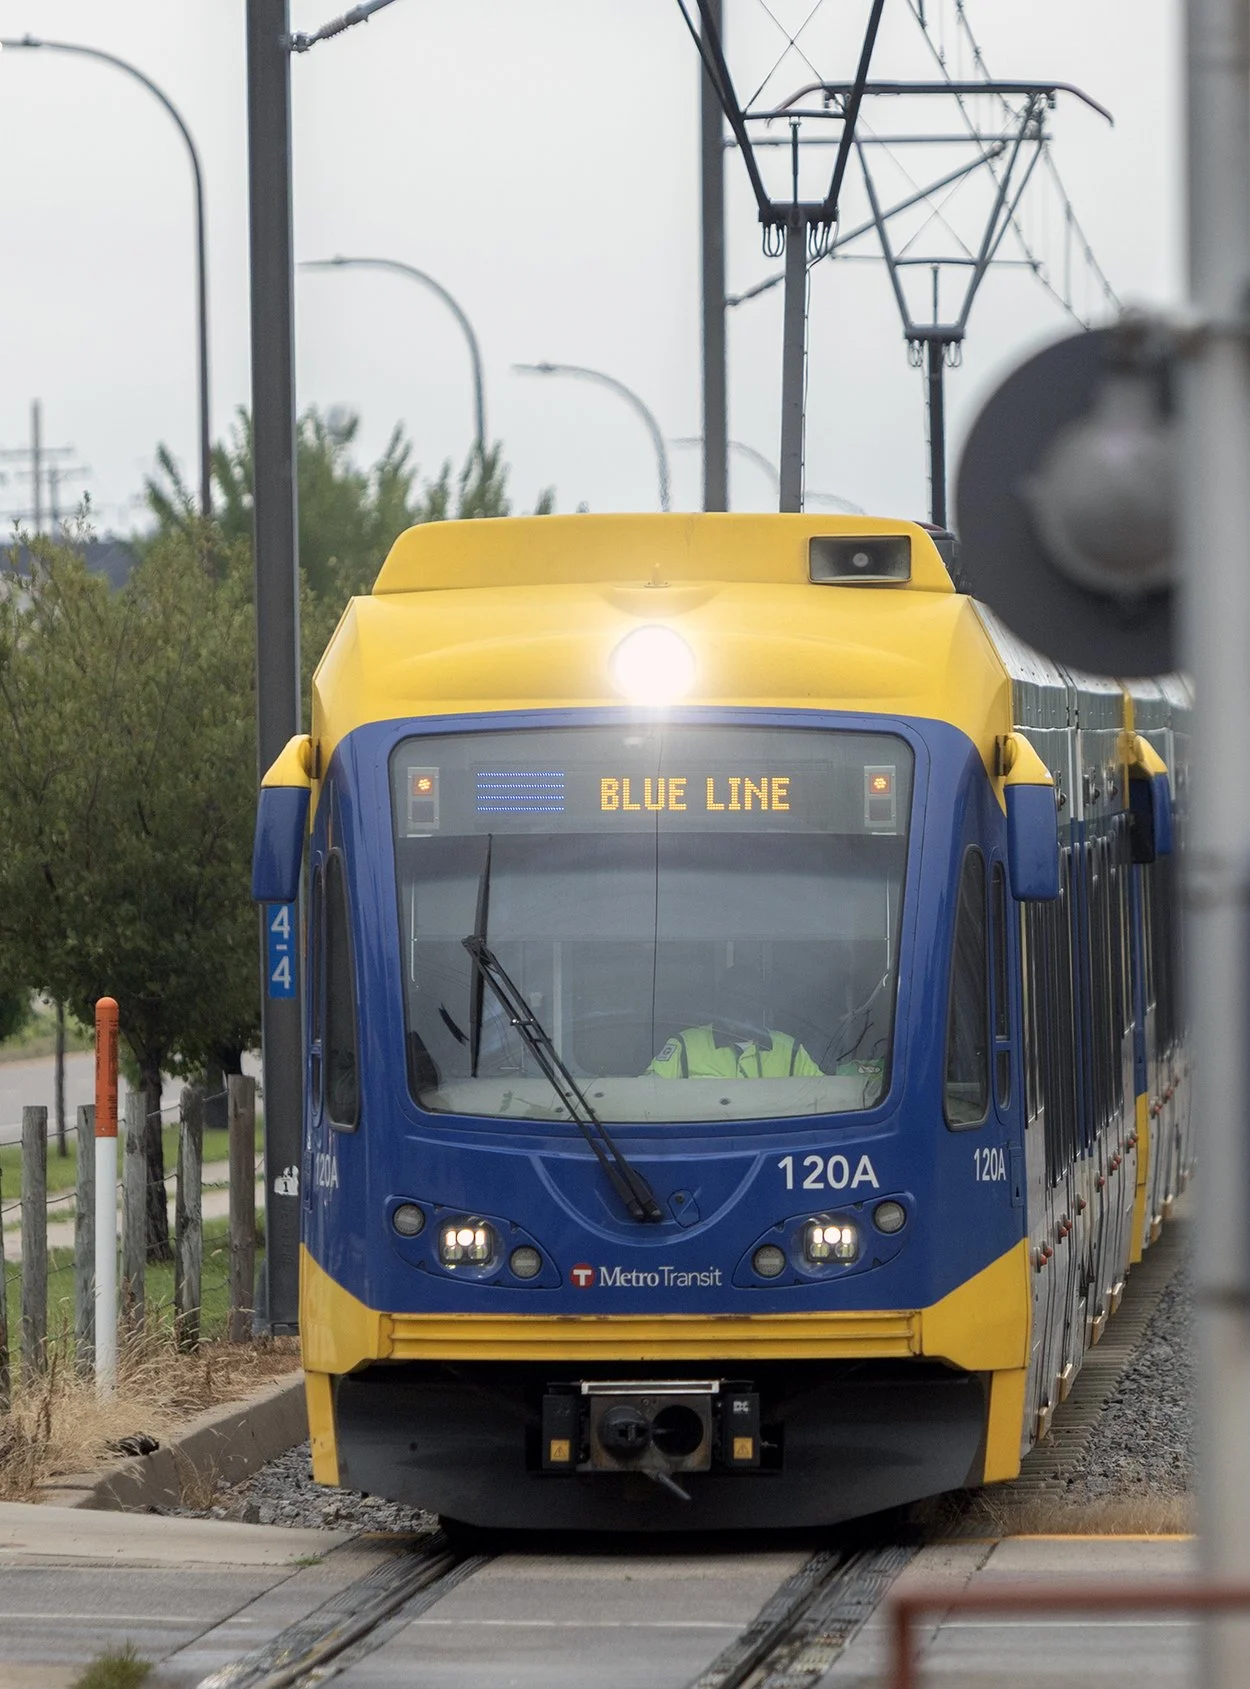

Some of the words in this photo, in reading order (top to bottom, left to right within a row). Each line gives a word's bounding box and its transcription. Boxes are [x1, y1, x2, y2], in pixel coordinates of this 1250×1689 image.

[600, 777, 687, 811] BLUE
[706, 777, 790, 811] LINE
[778, 1154, 880, 1190] 120A
[974, 1147, 1007, 1182] 120A
